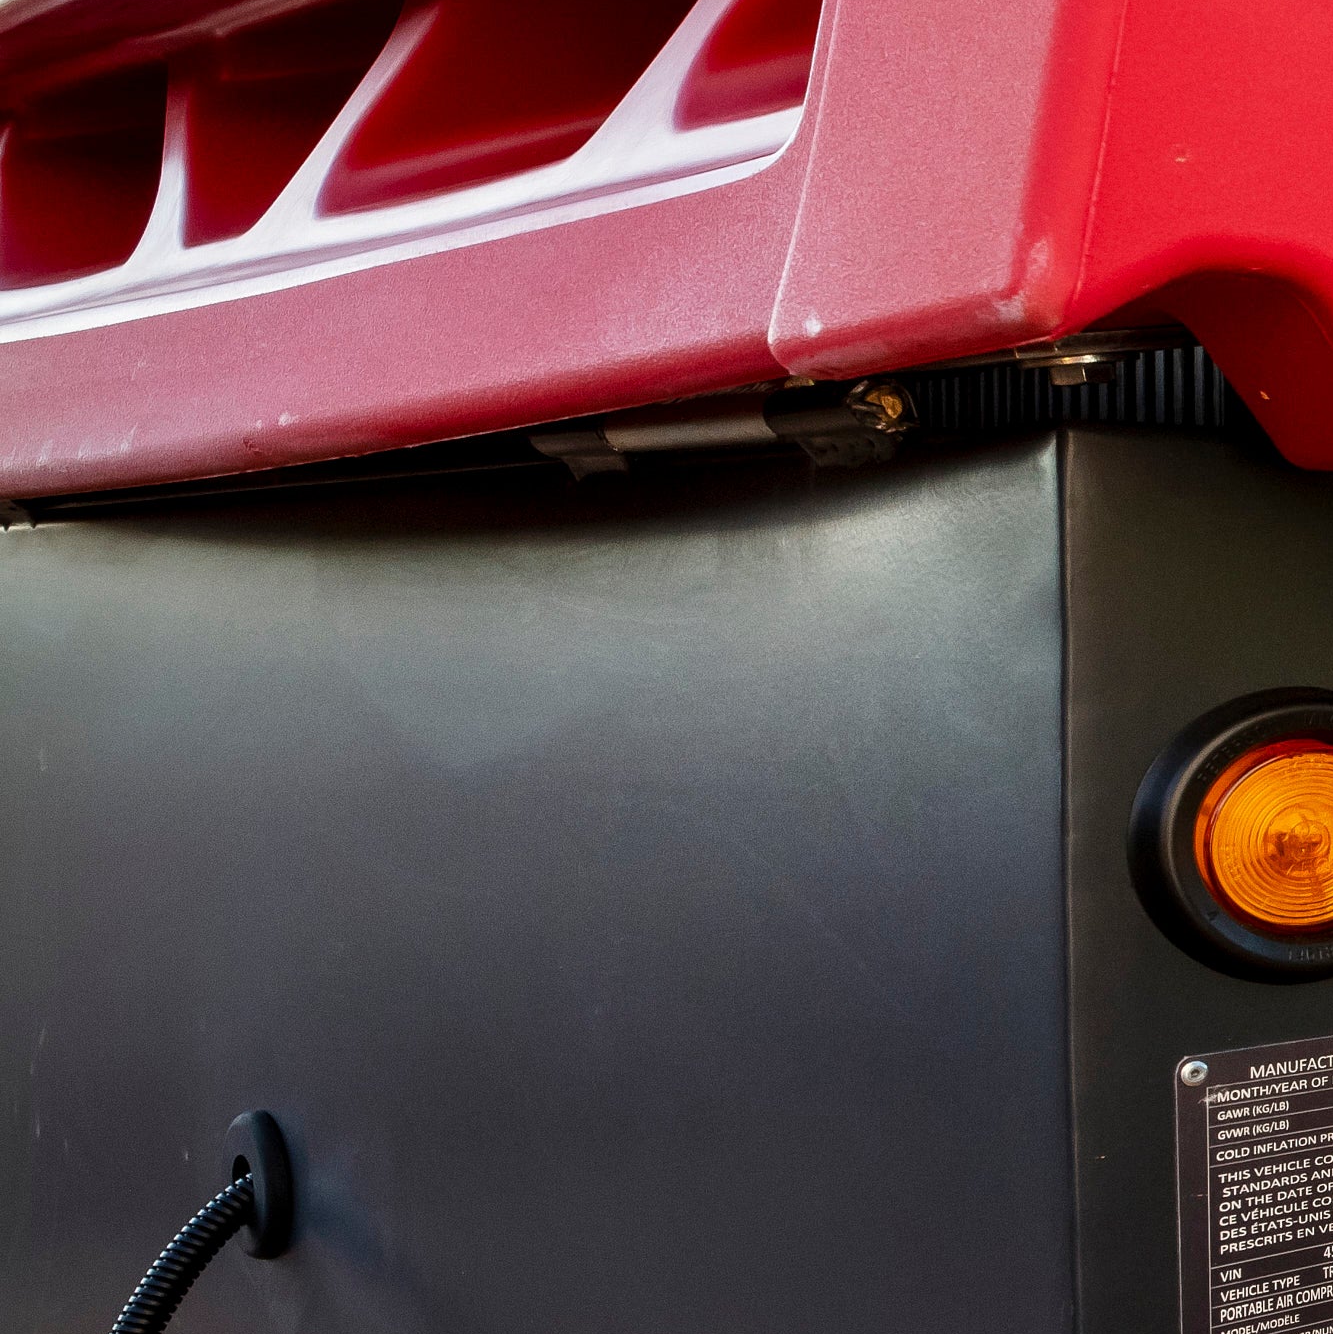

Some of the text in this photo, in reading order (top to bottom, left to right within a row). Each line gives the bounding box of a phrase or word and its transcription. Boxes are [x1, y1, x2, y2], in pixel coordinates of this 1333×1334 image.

[1216, 1079, 1308, 1104] MONTH/YEAR
[1310, 1075, 1329, 1088] OF
[1217, 1100, 1290, 1121] GAWR (KG/LB)
[1217, 1119, 1290, 1141] GVWR (KG/LB)
[1215, 1146, 1251, 1162] COLD
[1253, 1134, 1317, 1156] INFLATION
[1217, 1169, 1251, 1184] THIS
[1253, 1158, 1311, 1177] VEHICLE
[1222, 1172, 1308, 1198] STANDARDS
[1218, 1199, 1242, 1213] ON
[1244, 1192, 1274, 1207] THE
[1277, 1185, 1313, 1202] DATE
[1218, 1214, 1238, 1227] CE
[1240, 1200, 1309, 1222] VÉHICULE
[1219, 1226, 1248, 1241] DES
[1250, 1209, 1331, 1235] ÉTATS-UNIS
[1220, 1230, 1294, 1256] PRESCRITS
[1296, 1226, 1315, 1239] EN
[1219, 1267, 1242, 1283] VIN
[1220, 1274, 1301, 1303] VEHICLE TYPE
[1220, 1297, 1274, 1323] PORTABLE
[1275, 1293, 1294, 1310] AIR
